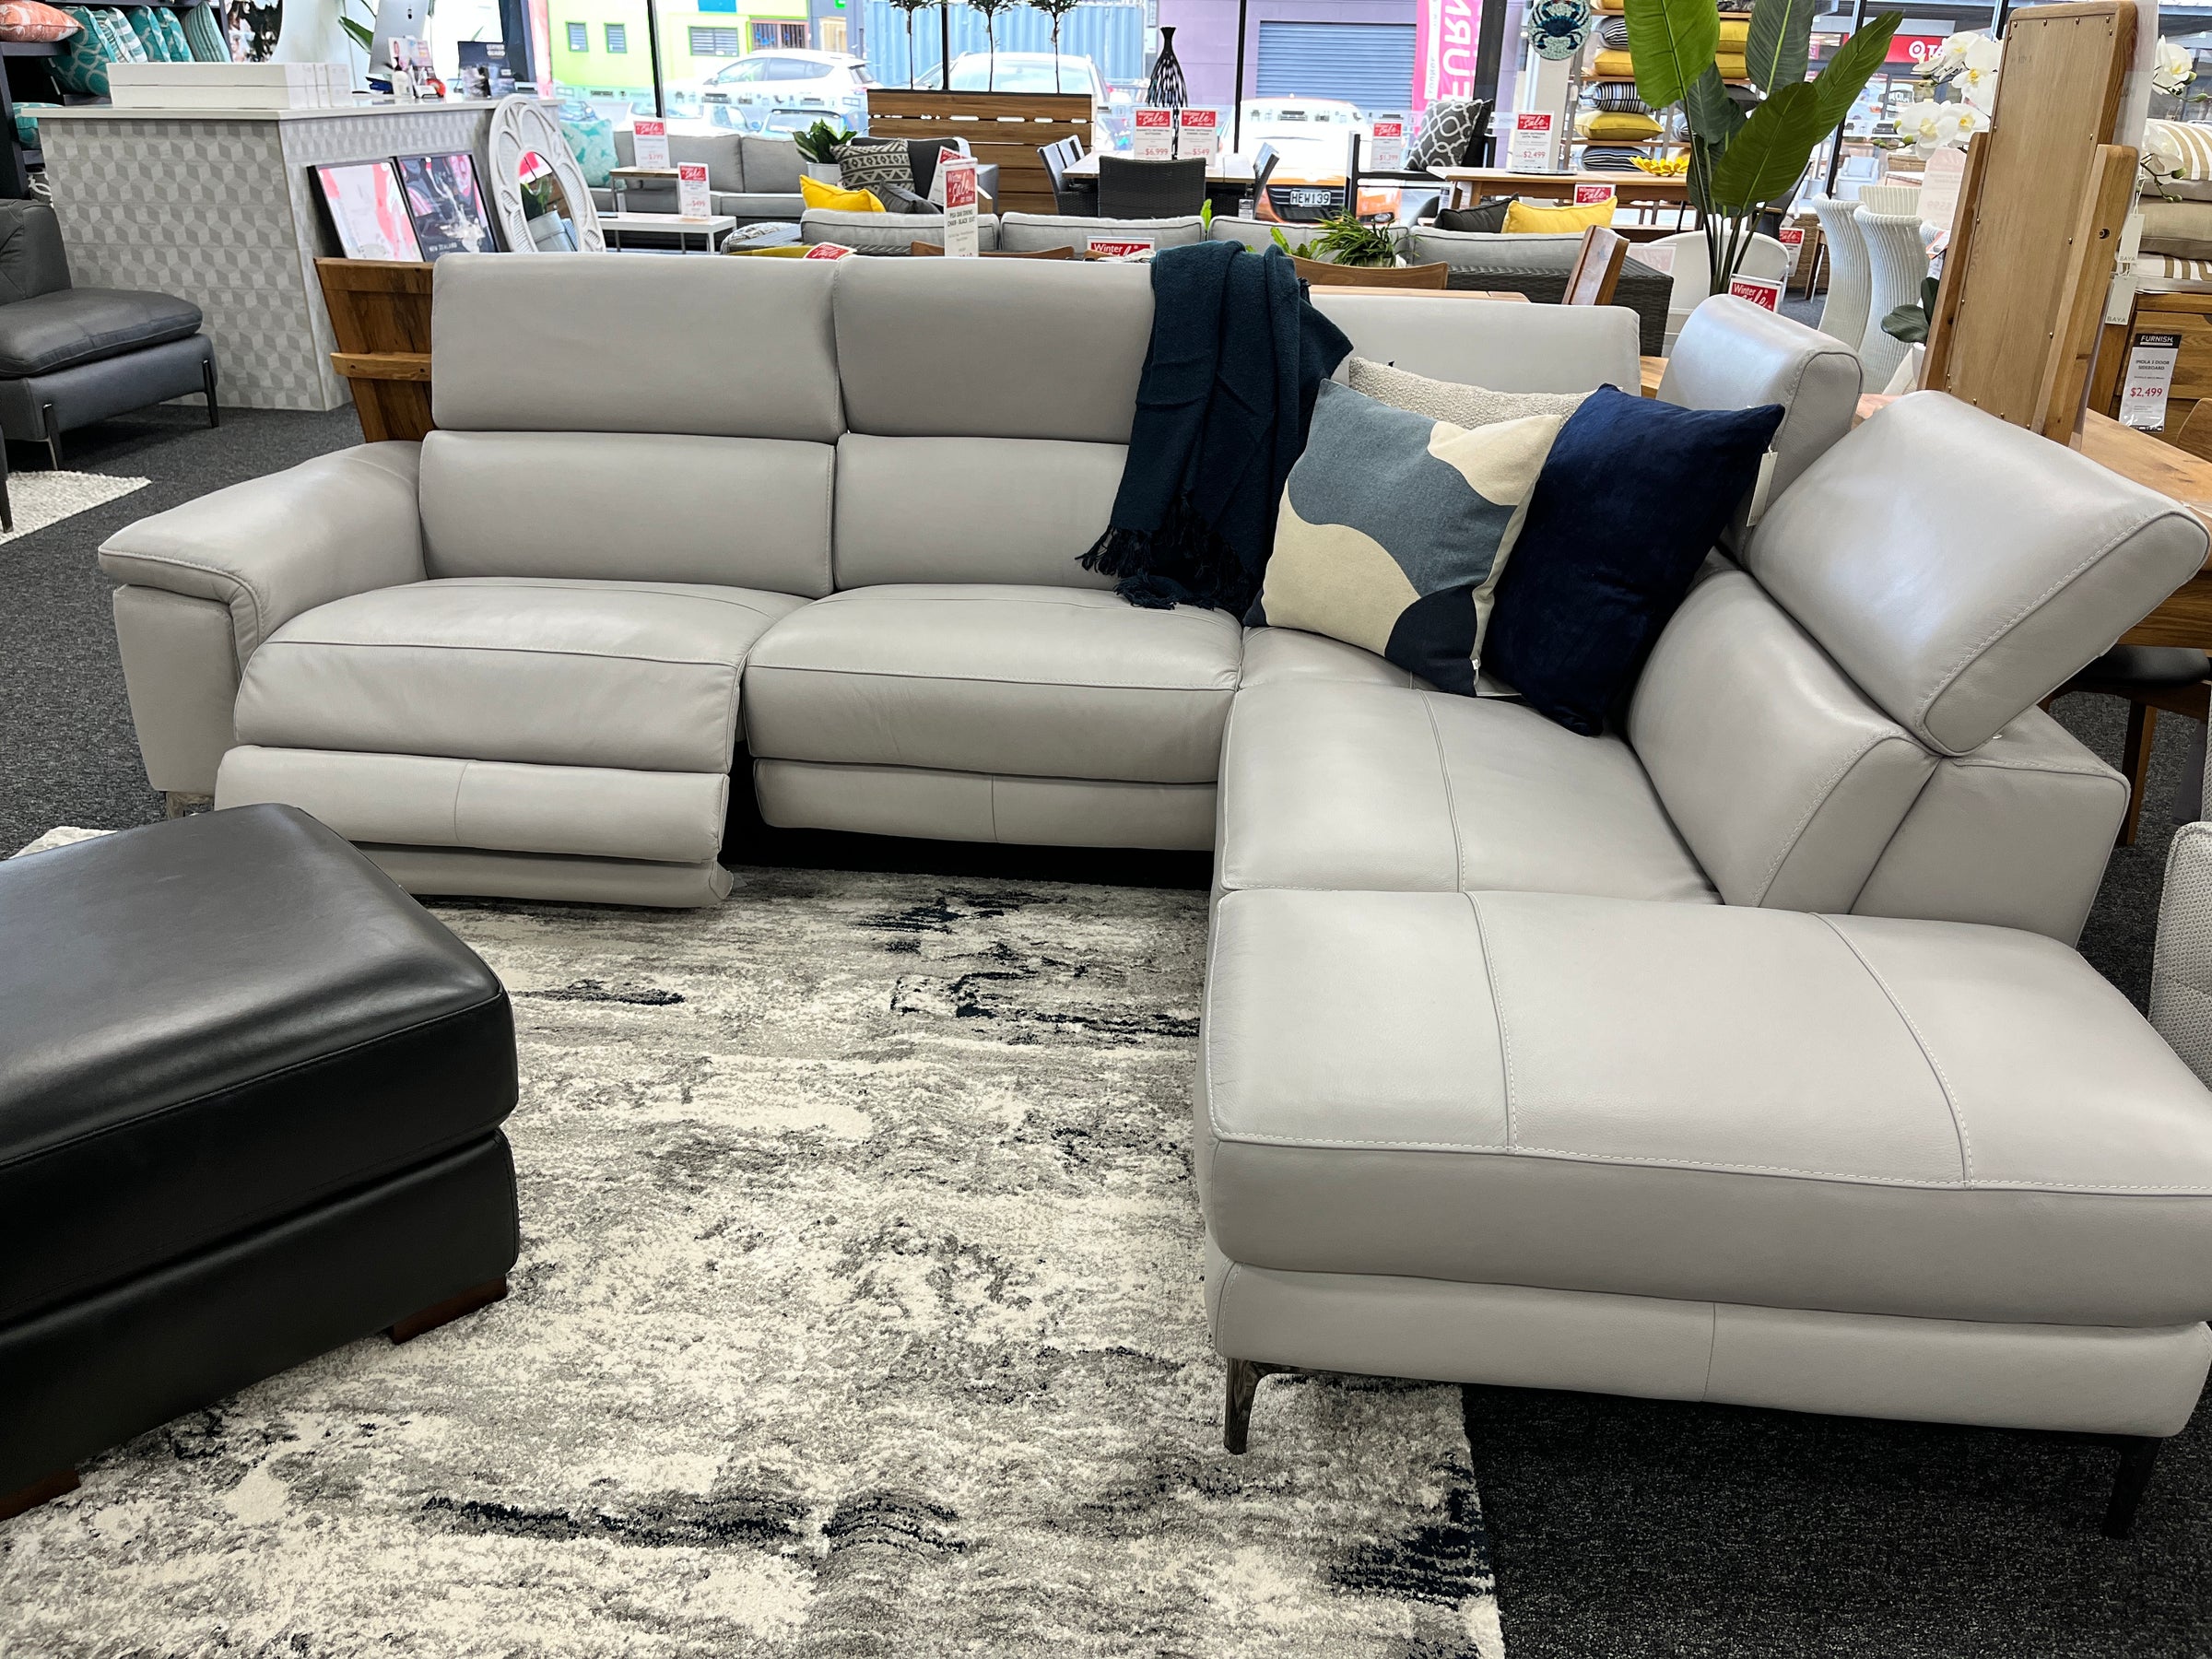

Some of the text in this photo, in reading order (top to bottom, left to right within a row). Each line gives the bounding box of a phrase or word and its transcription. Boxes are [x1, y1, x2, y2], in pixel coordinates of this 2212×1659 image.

[1142, 112, 1165, 125] sale
[1187, 112, 1210, 125] sale
[1523, 116, 1545, 128] sale
[1291, 193, 1330, 204] HEW139
[1583, 188, 1606, 202] sale
[1094, 243, 1123, 253] Winter
[1734, 283, 1757, 295] Winter
[2130, 387, 2163, 398] $2,499
